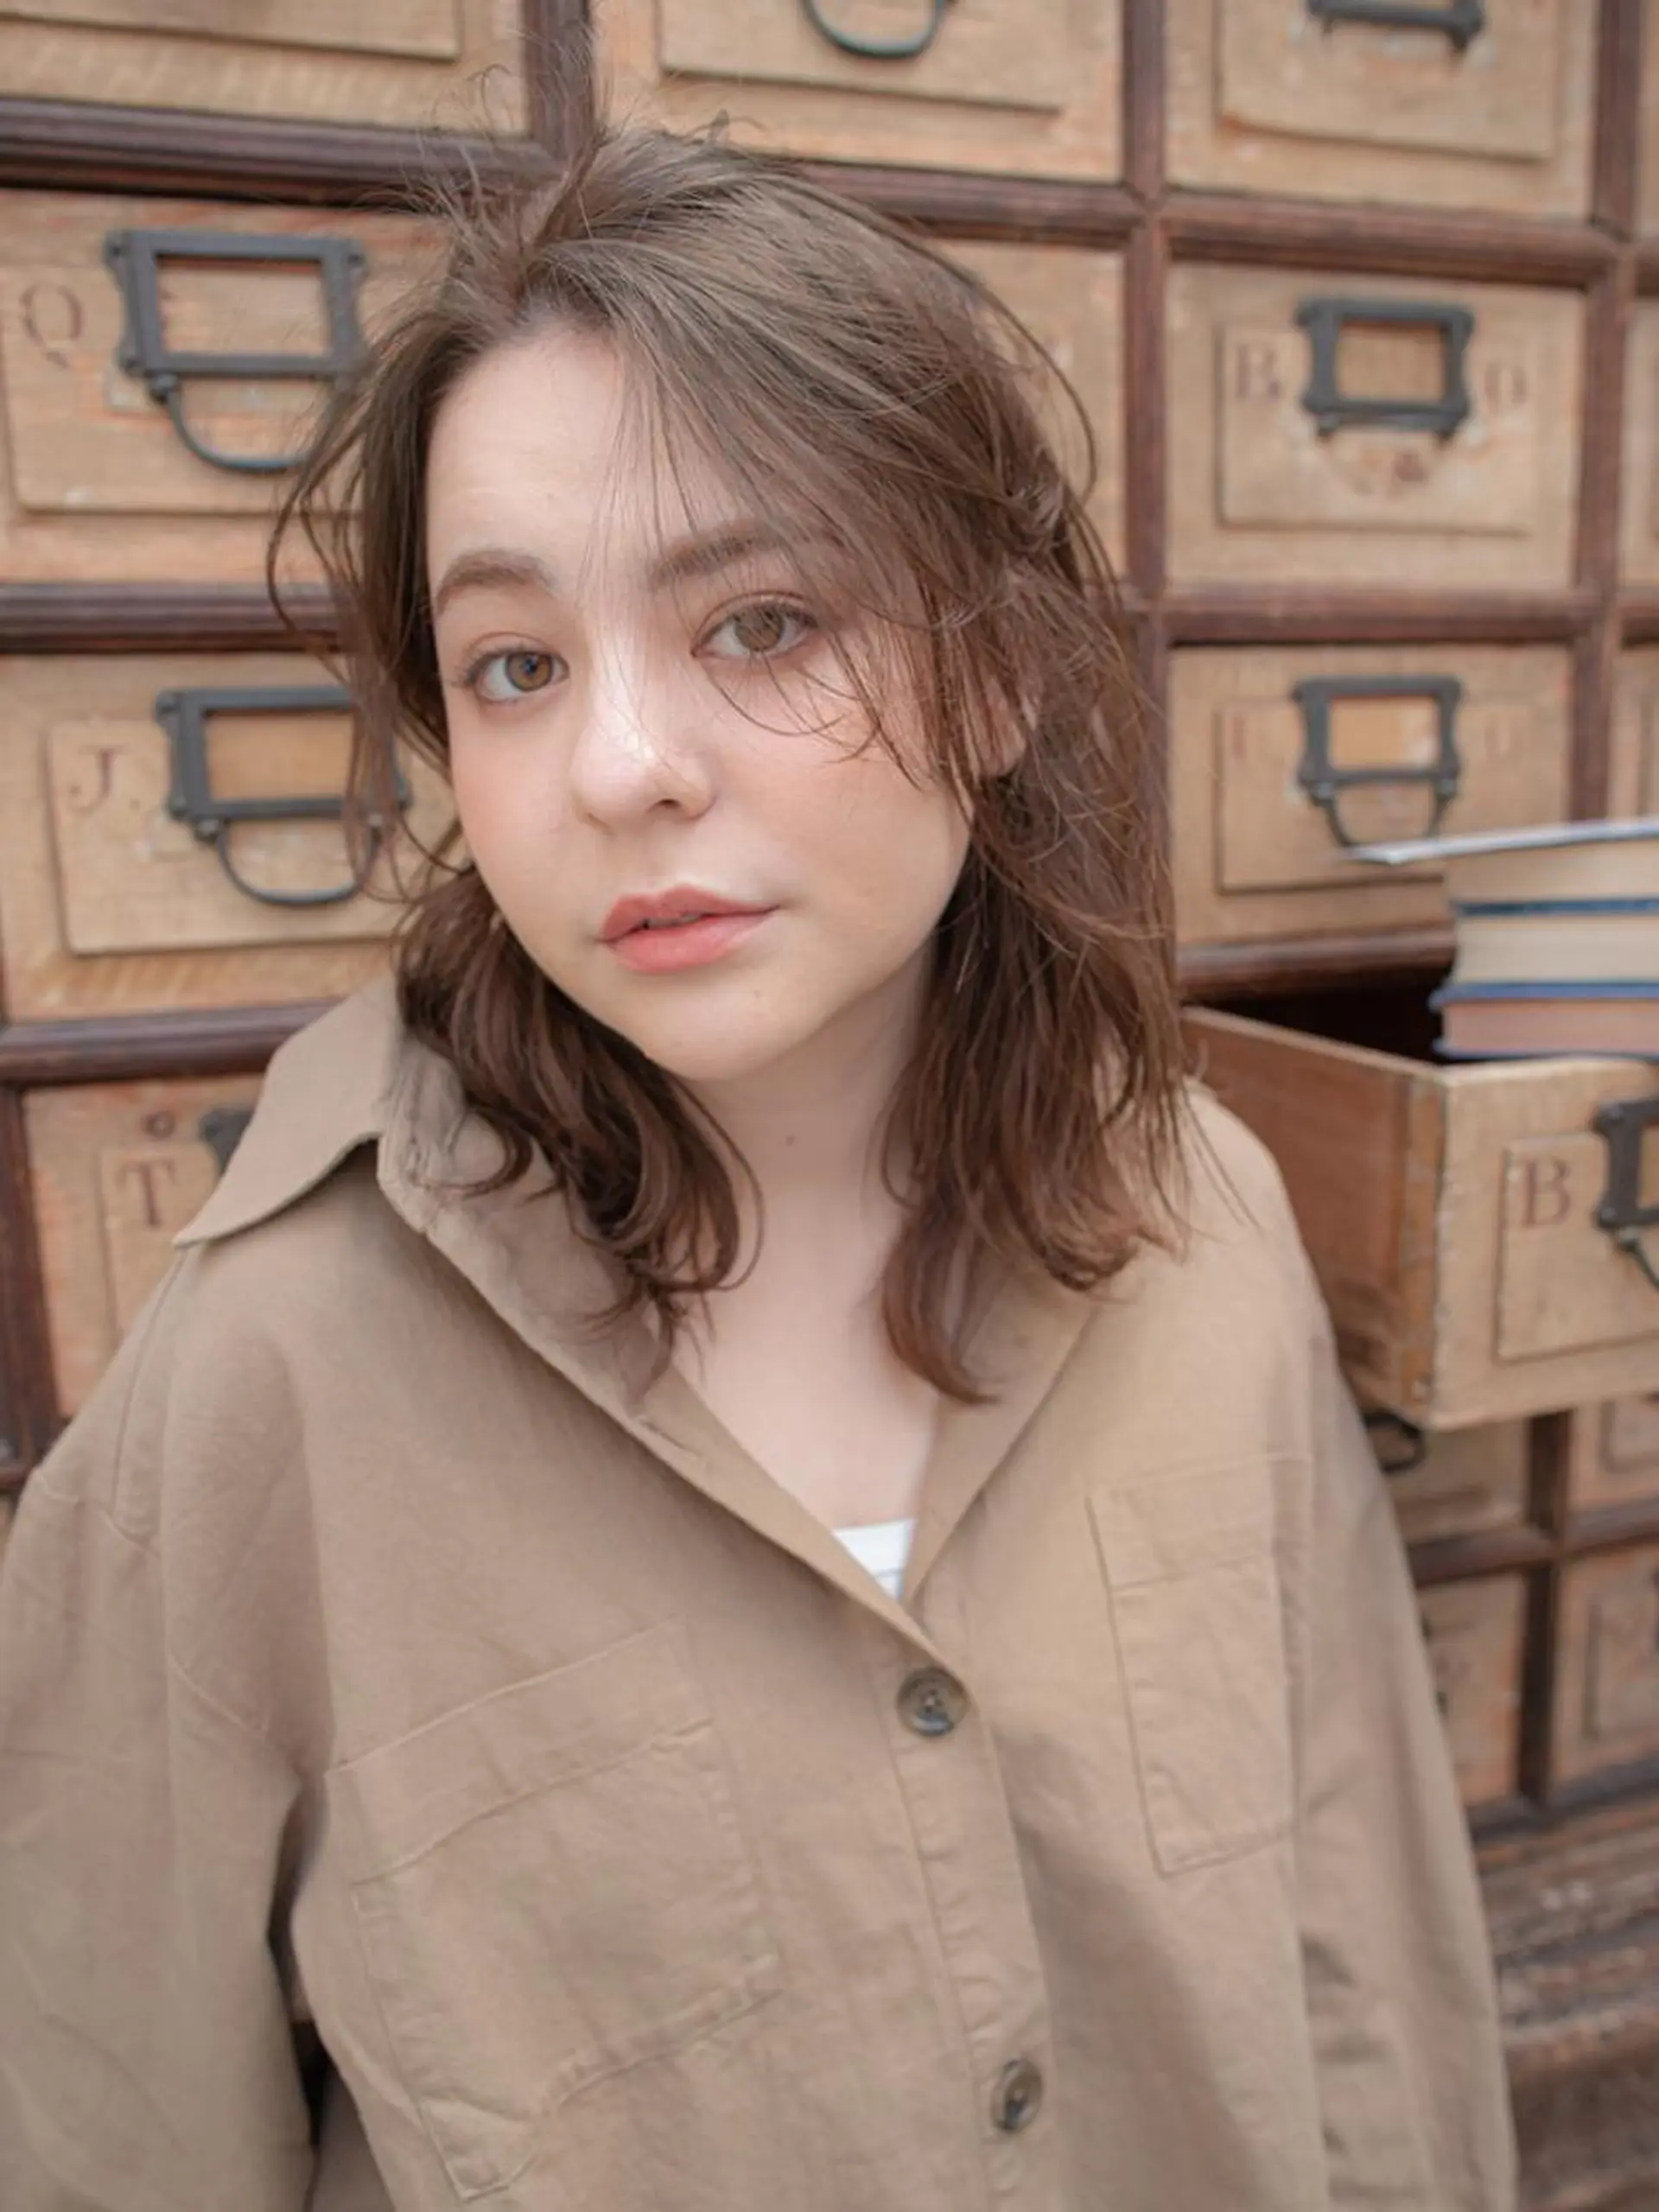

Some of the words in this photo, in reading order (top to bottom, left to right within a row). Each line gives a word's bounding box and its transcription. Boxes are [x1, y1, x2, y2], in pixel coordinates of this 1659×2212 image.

[19, 282, 83, 370] Q
[115, 1159, 177, 1229] T
[1518, 1155, 1572, 1229] B
